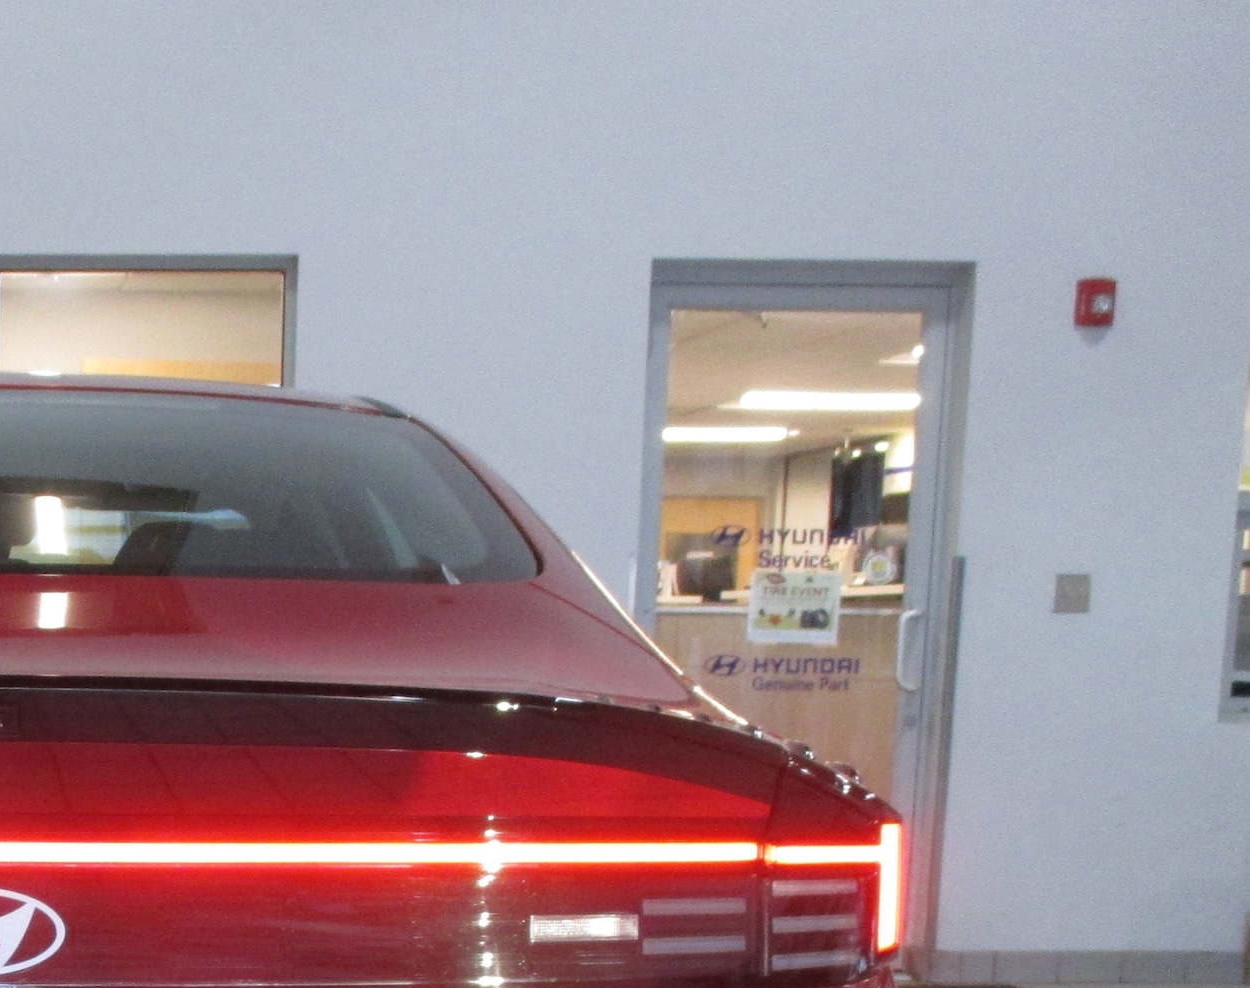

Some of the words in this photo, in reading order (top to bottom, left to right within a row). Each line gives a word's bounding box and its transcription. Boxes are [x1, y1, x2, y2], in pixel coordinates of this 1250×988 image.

[758, 550, 831, 568] Service
[752, 657, 861, 674] HYUNDAI
[752, 676, 815, 691] Genuine
